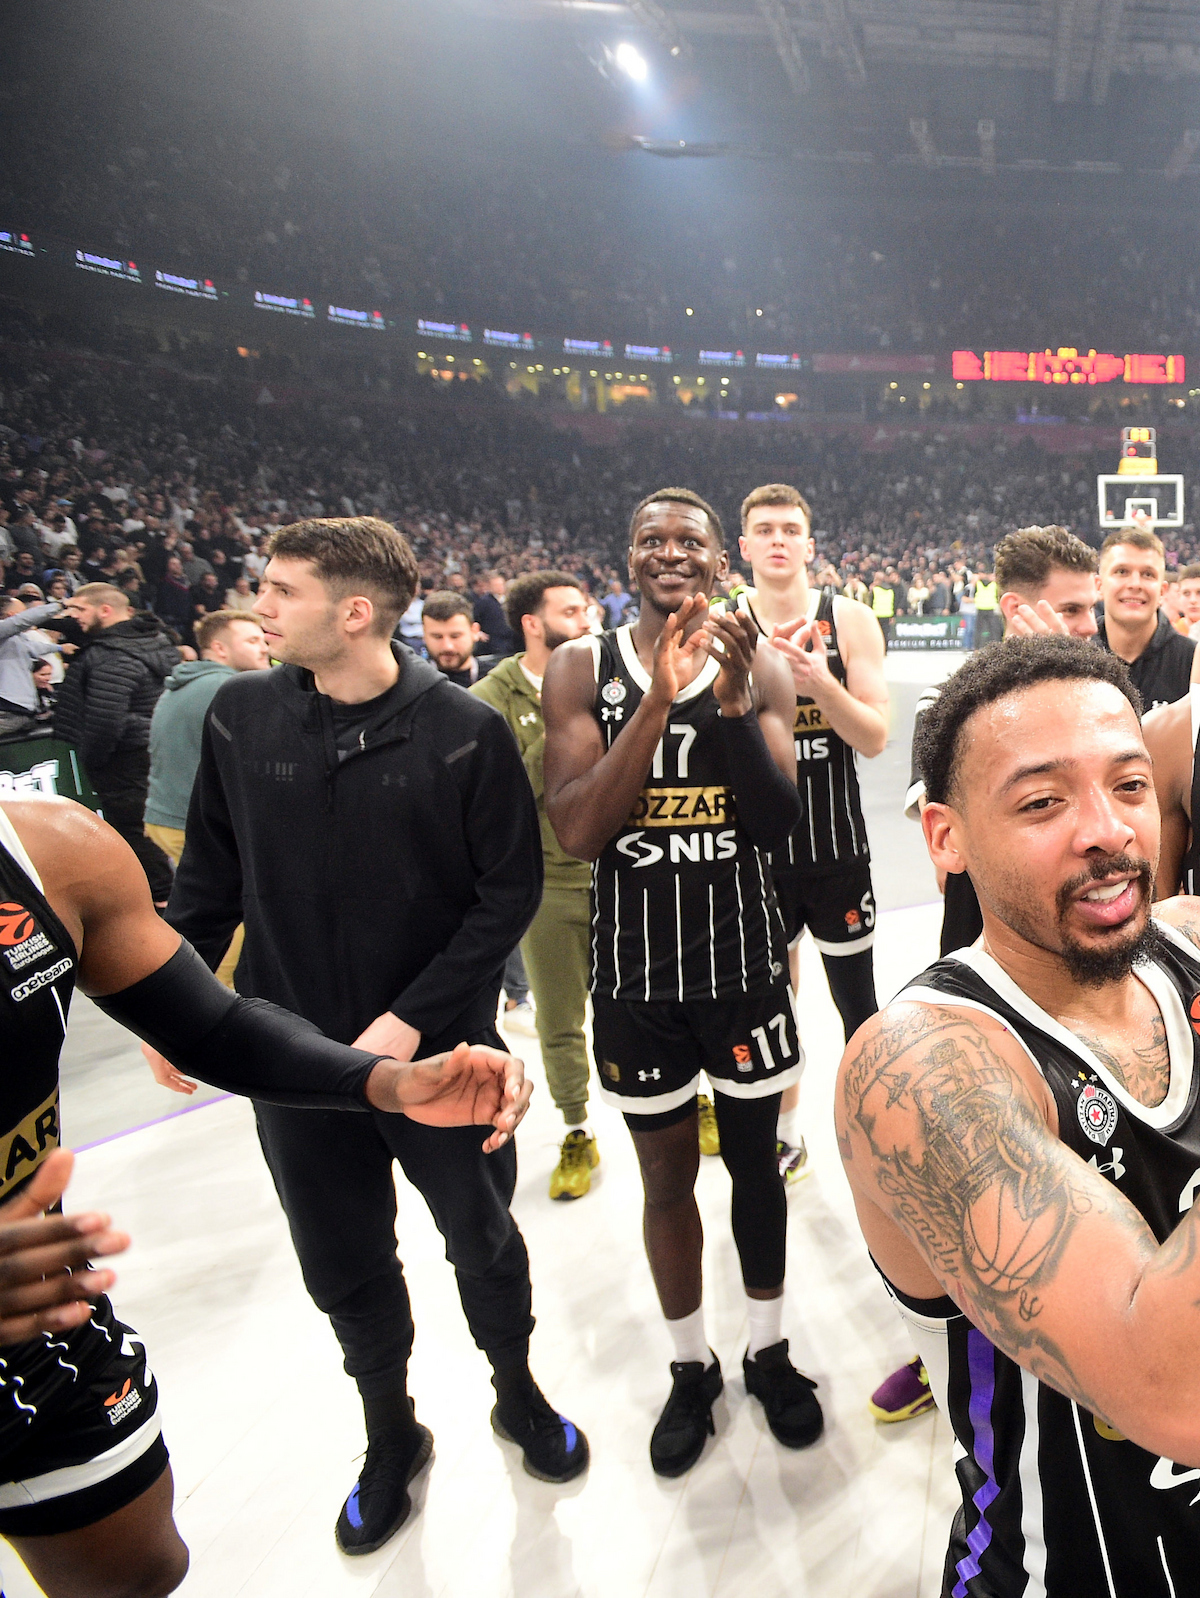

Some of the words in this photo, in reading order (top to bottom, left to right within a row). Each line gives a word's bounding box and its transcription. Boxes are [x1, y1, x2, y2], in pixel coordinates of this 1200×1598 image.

[669, 829, 738, 864] NIS
[3, 931, 46, 958] TURKISH
[9, 938, 50, 966] AIRLINES
[750, 1012, 792, 1070] 17
